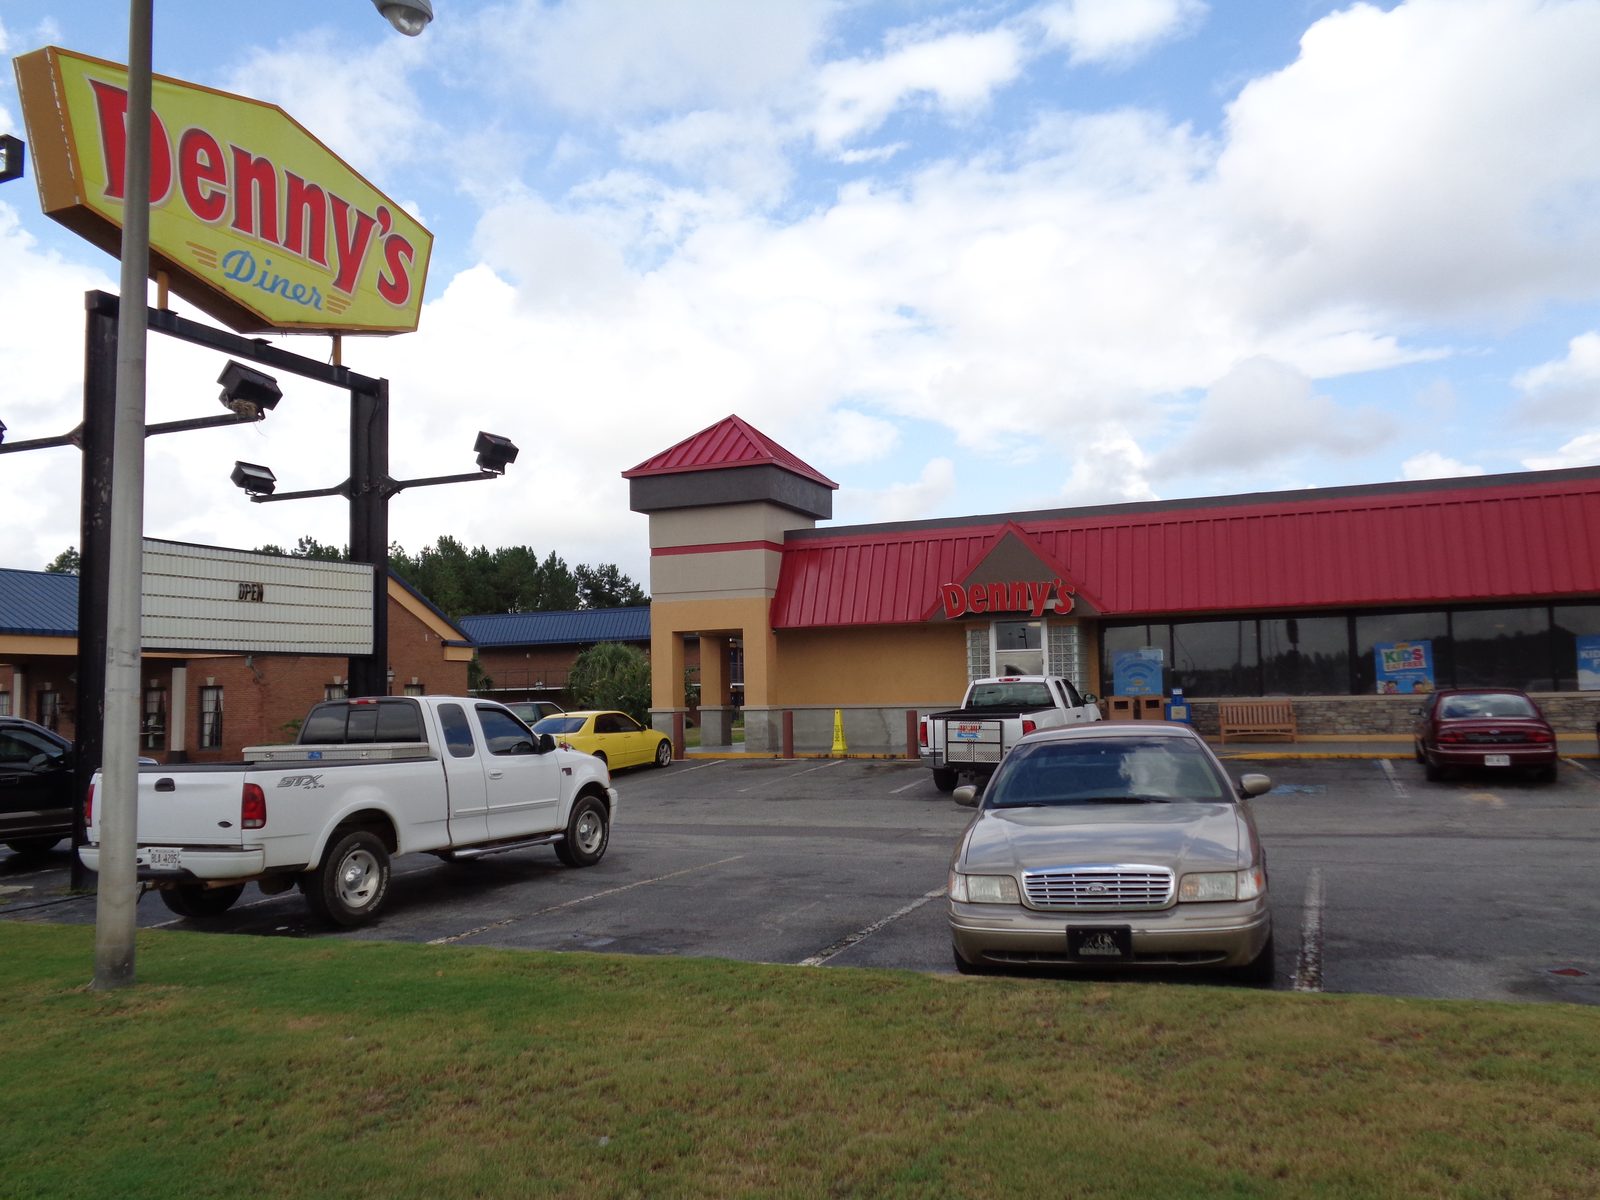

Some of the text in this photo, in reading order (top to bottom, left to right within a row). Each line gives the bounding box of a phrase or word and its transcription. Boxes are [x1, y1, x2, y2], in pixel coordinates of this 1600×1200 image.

[89, 78, 414, 305] Denny's
[221, 249, 323, 311] Diner
[238, 583, 263, 602] OPEN
[941, 578, 1075, 619] Denny's
[1384, 648, 1424, 663] KIDS
[277, 775, 323, 788] STX
